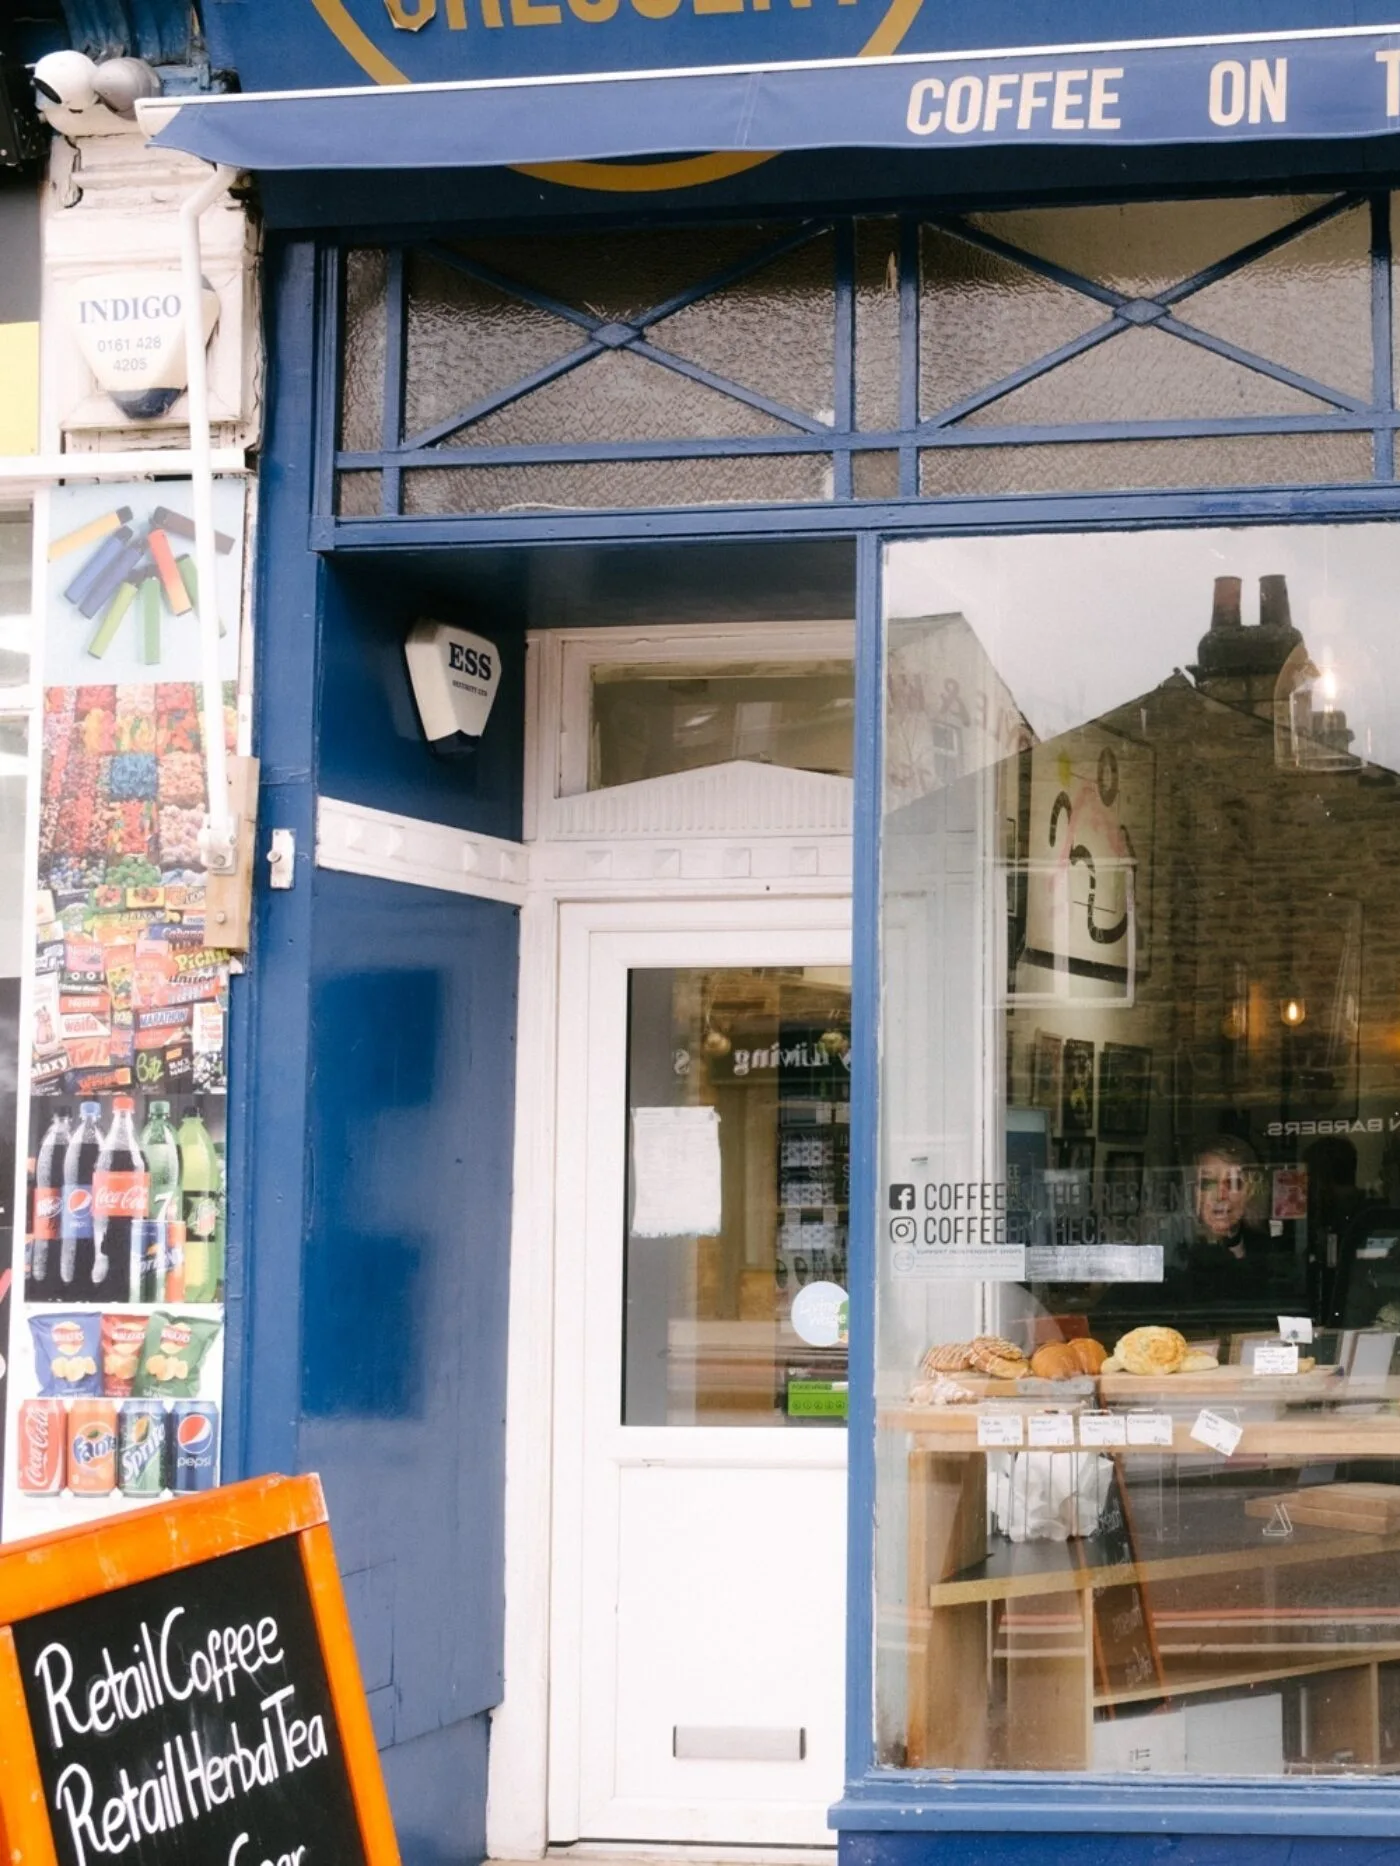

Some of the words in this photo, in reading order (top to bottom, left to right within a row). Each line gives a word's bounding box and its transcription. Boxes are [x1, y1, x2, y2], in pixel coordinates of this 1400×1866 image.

[906, 66, 1124, 137] COFFEE
[1208, 58, 1287, 128] ON
[79, 294, 182, 324] INDIGO
[97, 338, 130, 353] 0161
[448, 641, 492, 681] ESS
[177, 1456, 212, 1471] pepsi
[34, 1621, 164, 1748] Retail
[160, 1606, 284, 1703] Coffee
[56, 1740, 184, 1866] Retail
[175, 1716, 279, 1820] Herbal
[260, 1684, 329, 1774] Tea
